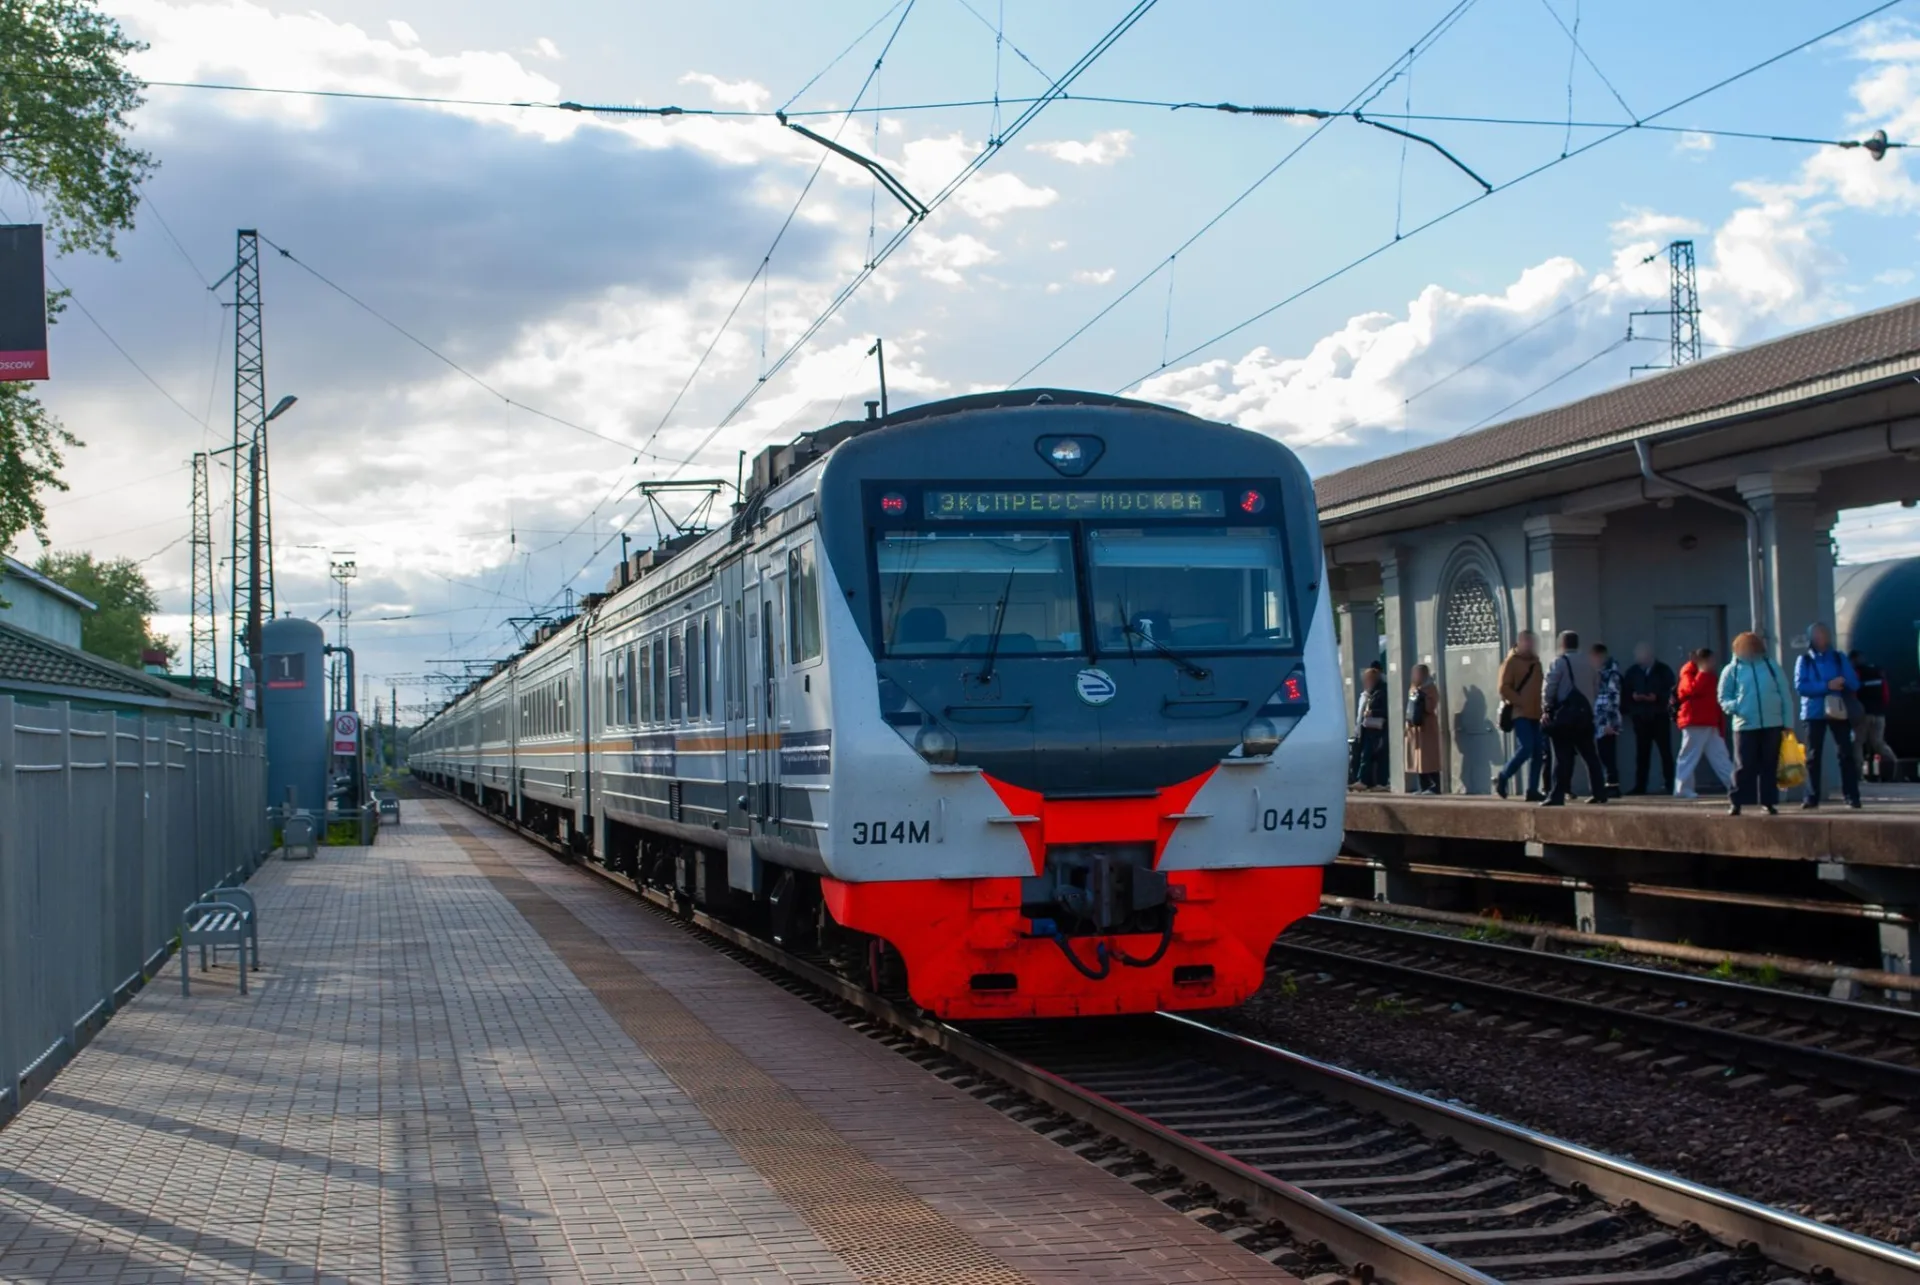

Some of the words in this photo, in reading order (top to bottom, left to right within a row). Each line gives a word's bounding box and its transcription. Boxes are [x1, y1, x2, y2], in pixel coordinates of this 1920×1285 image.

[280, 656, 290, 677] 1
[1264, 807, 1328, 831] 0445
[852, 820, 930, 845] ЭД4М
